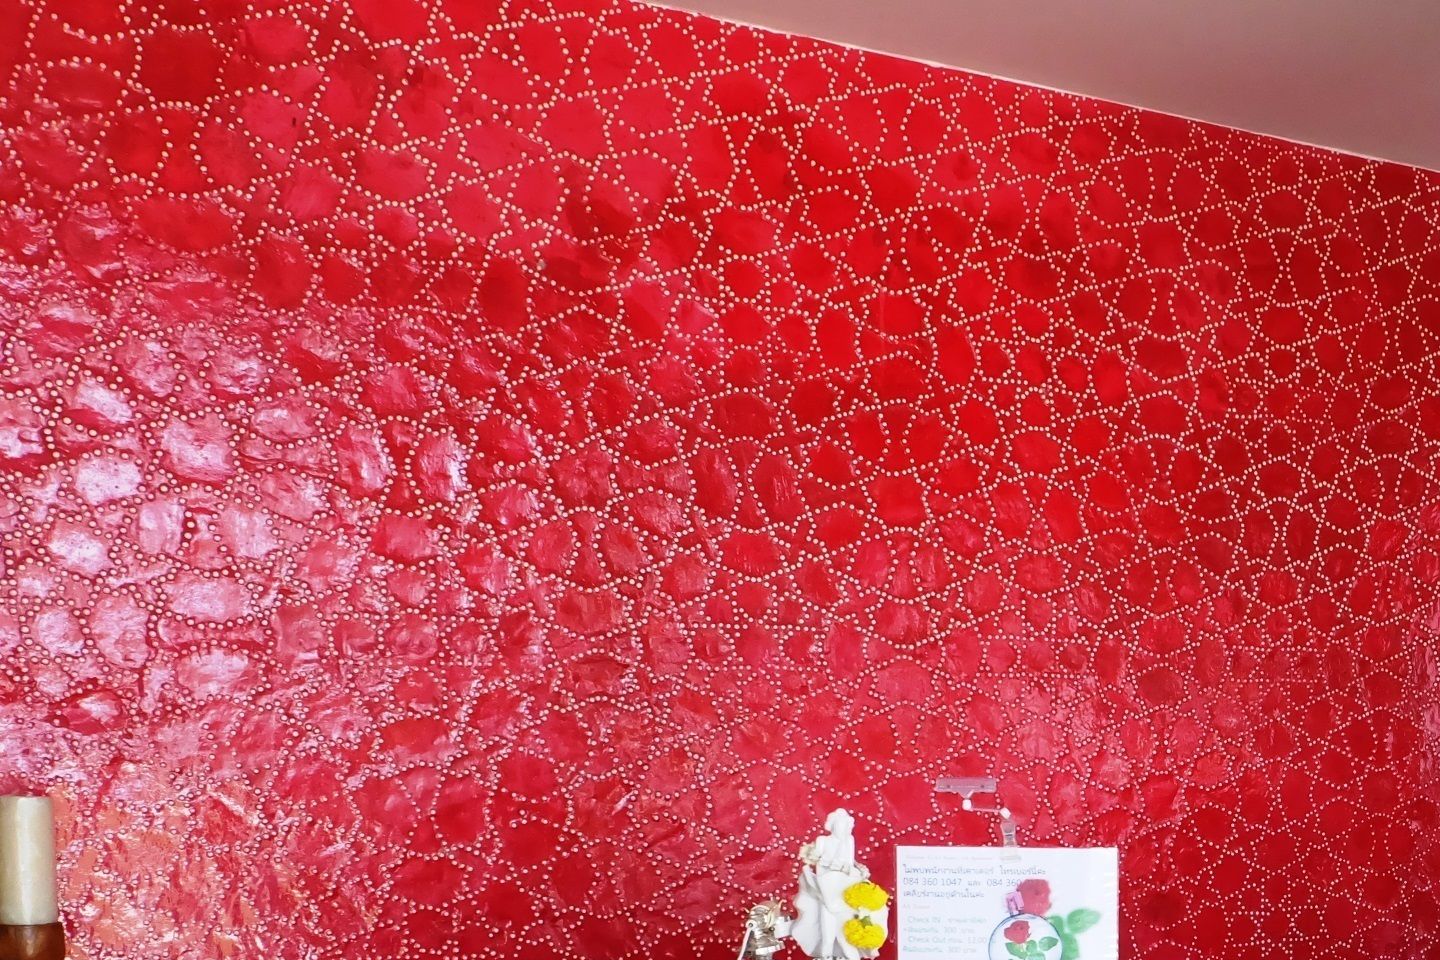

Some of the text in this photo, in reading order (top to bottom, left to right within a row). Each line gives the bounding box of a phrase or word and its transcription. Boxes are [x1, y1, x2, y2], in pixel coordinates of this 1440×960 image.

[903, 877, 919, 886] 084
[922, 877, 938, 886] 360
[941, 878, 962, 886] 1047
[986, 878, 1003, 887] 084
[908, 916, 930, 924] Check
[908, 936, 930, 944] Check
